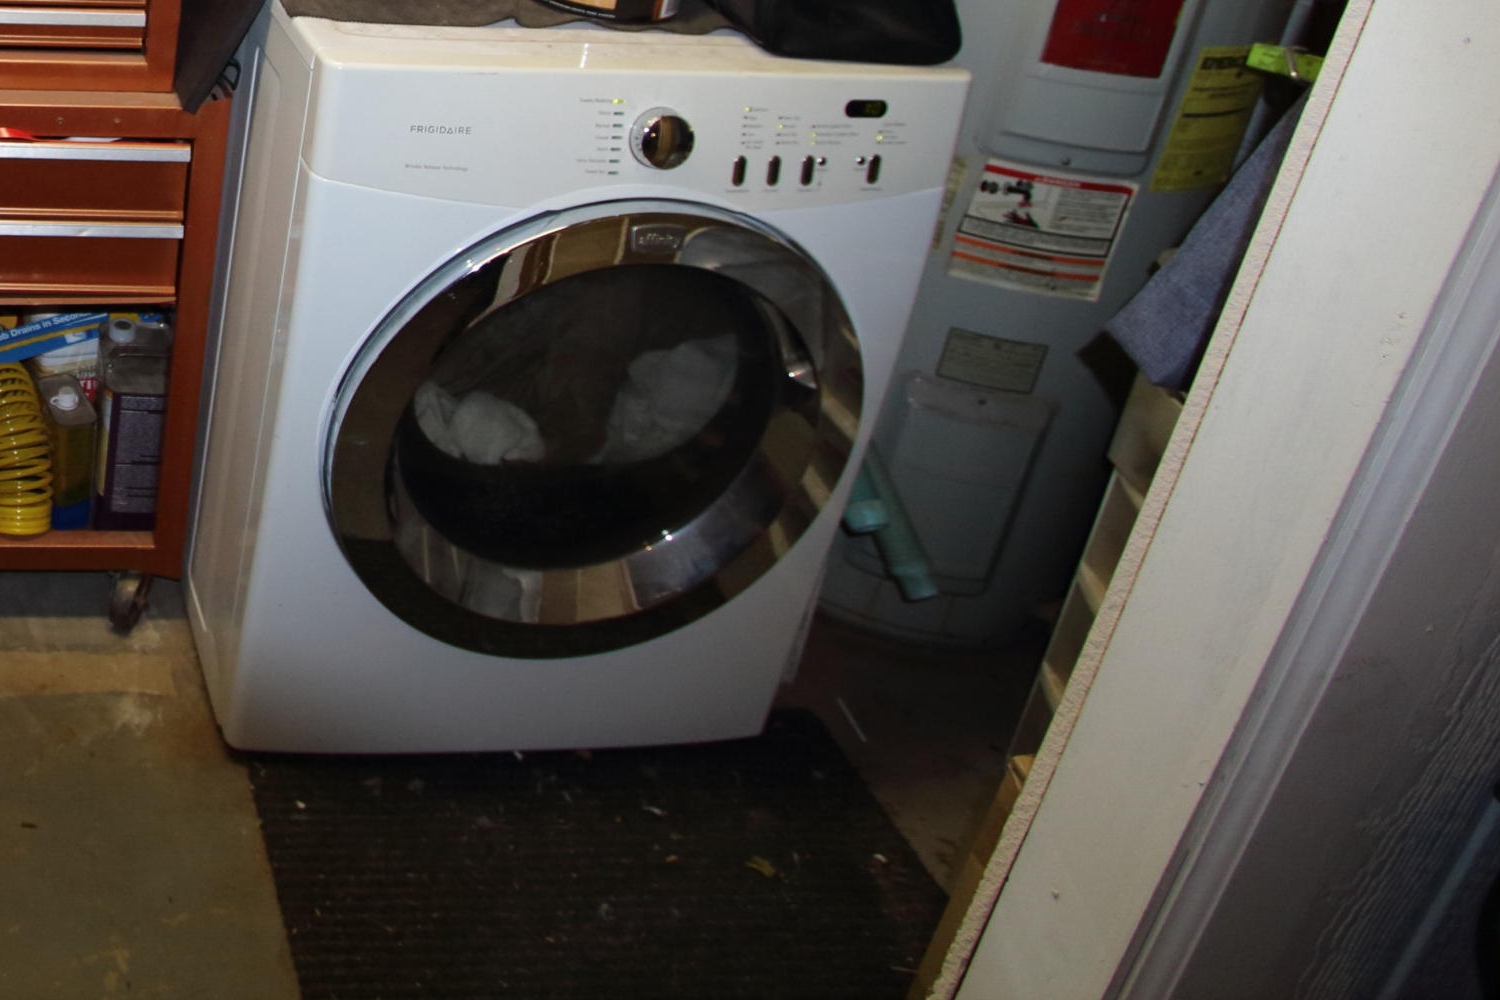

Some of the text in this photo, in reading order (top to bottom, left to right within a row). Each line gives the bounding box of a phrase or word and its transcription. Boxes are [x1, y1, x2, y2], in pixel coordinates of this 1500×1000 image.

[410, 125, 472, 135] FRIGIDAIRE
[11, 323, 42, 337] Drains
[42, 319, 52, 328] in
